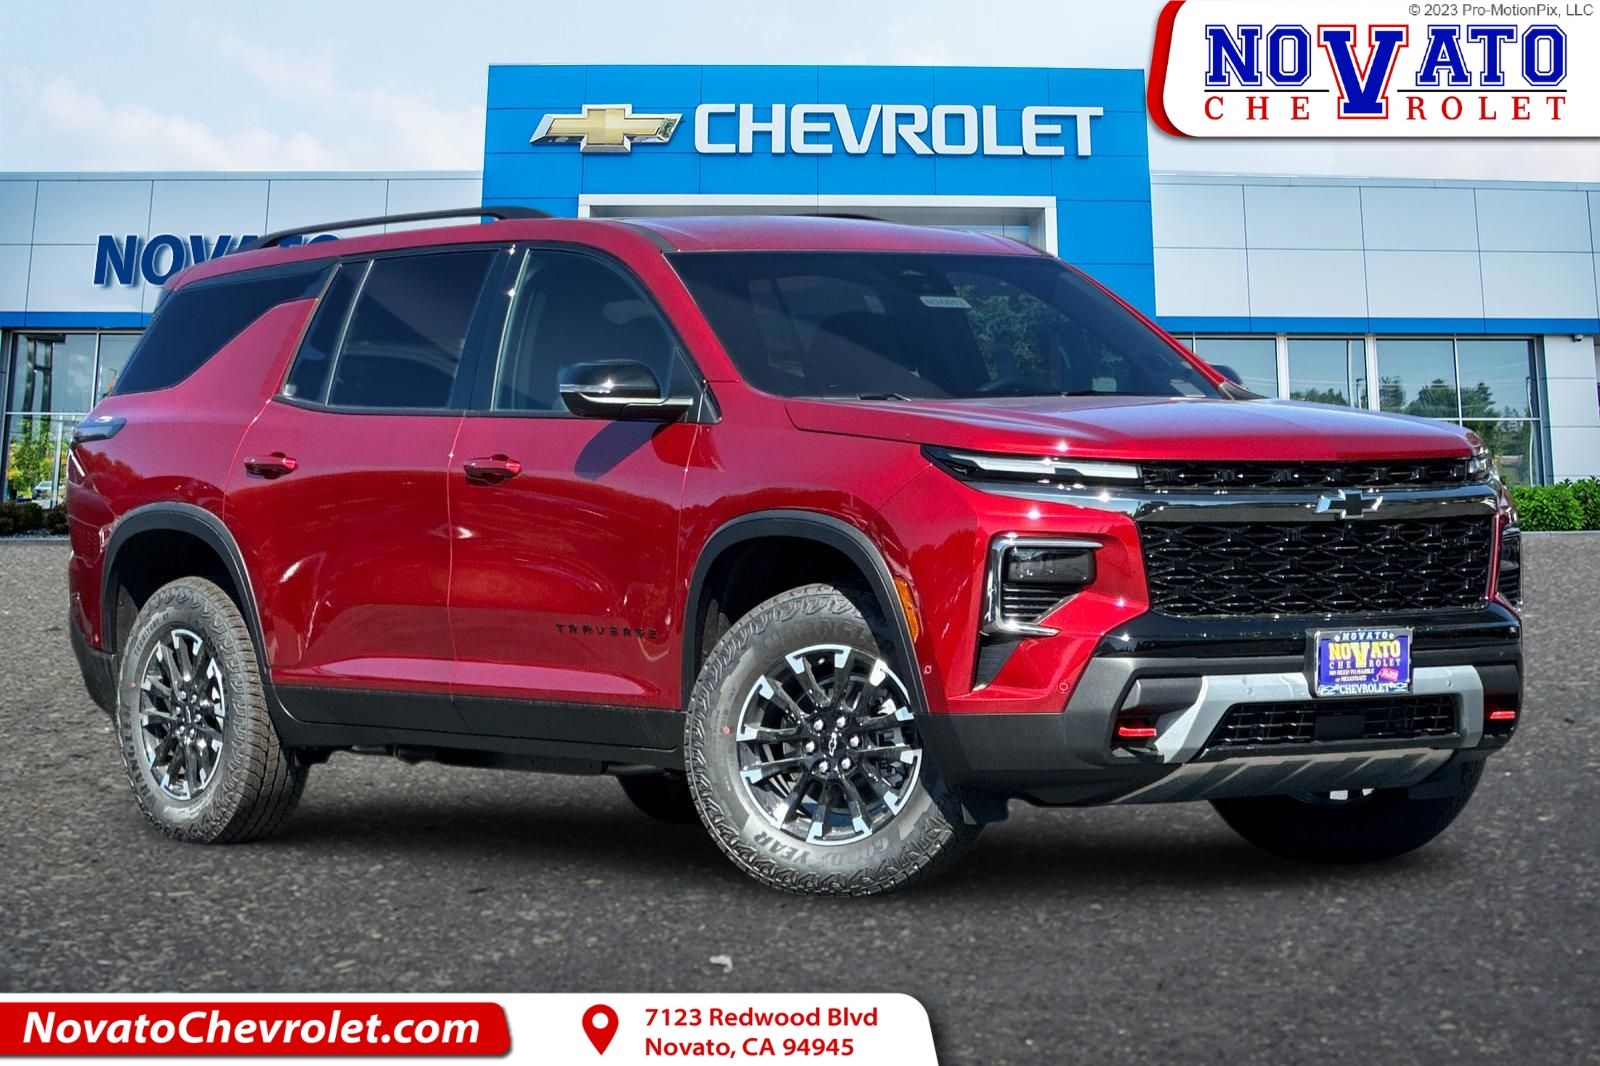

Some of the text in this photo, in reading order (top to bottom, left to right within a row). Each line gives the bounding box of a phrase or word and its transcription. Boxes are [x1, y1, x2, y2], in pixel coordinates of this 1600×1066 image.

[694, 104, 1104, 157] CHEVROLET
[556, 623, 657, 639] TRAVERSE
[1342, 631, 1389, 641] NOVATO
[1328, 640, 1401, 668] NOVATO
[1339, 682, 1390, 695] CHEVROLET
